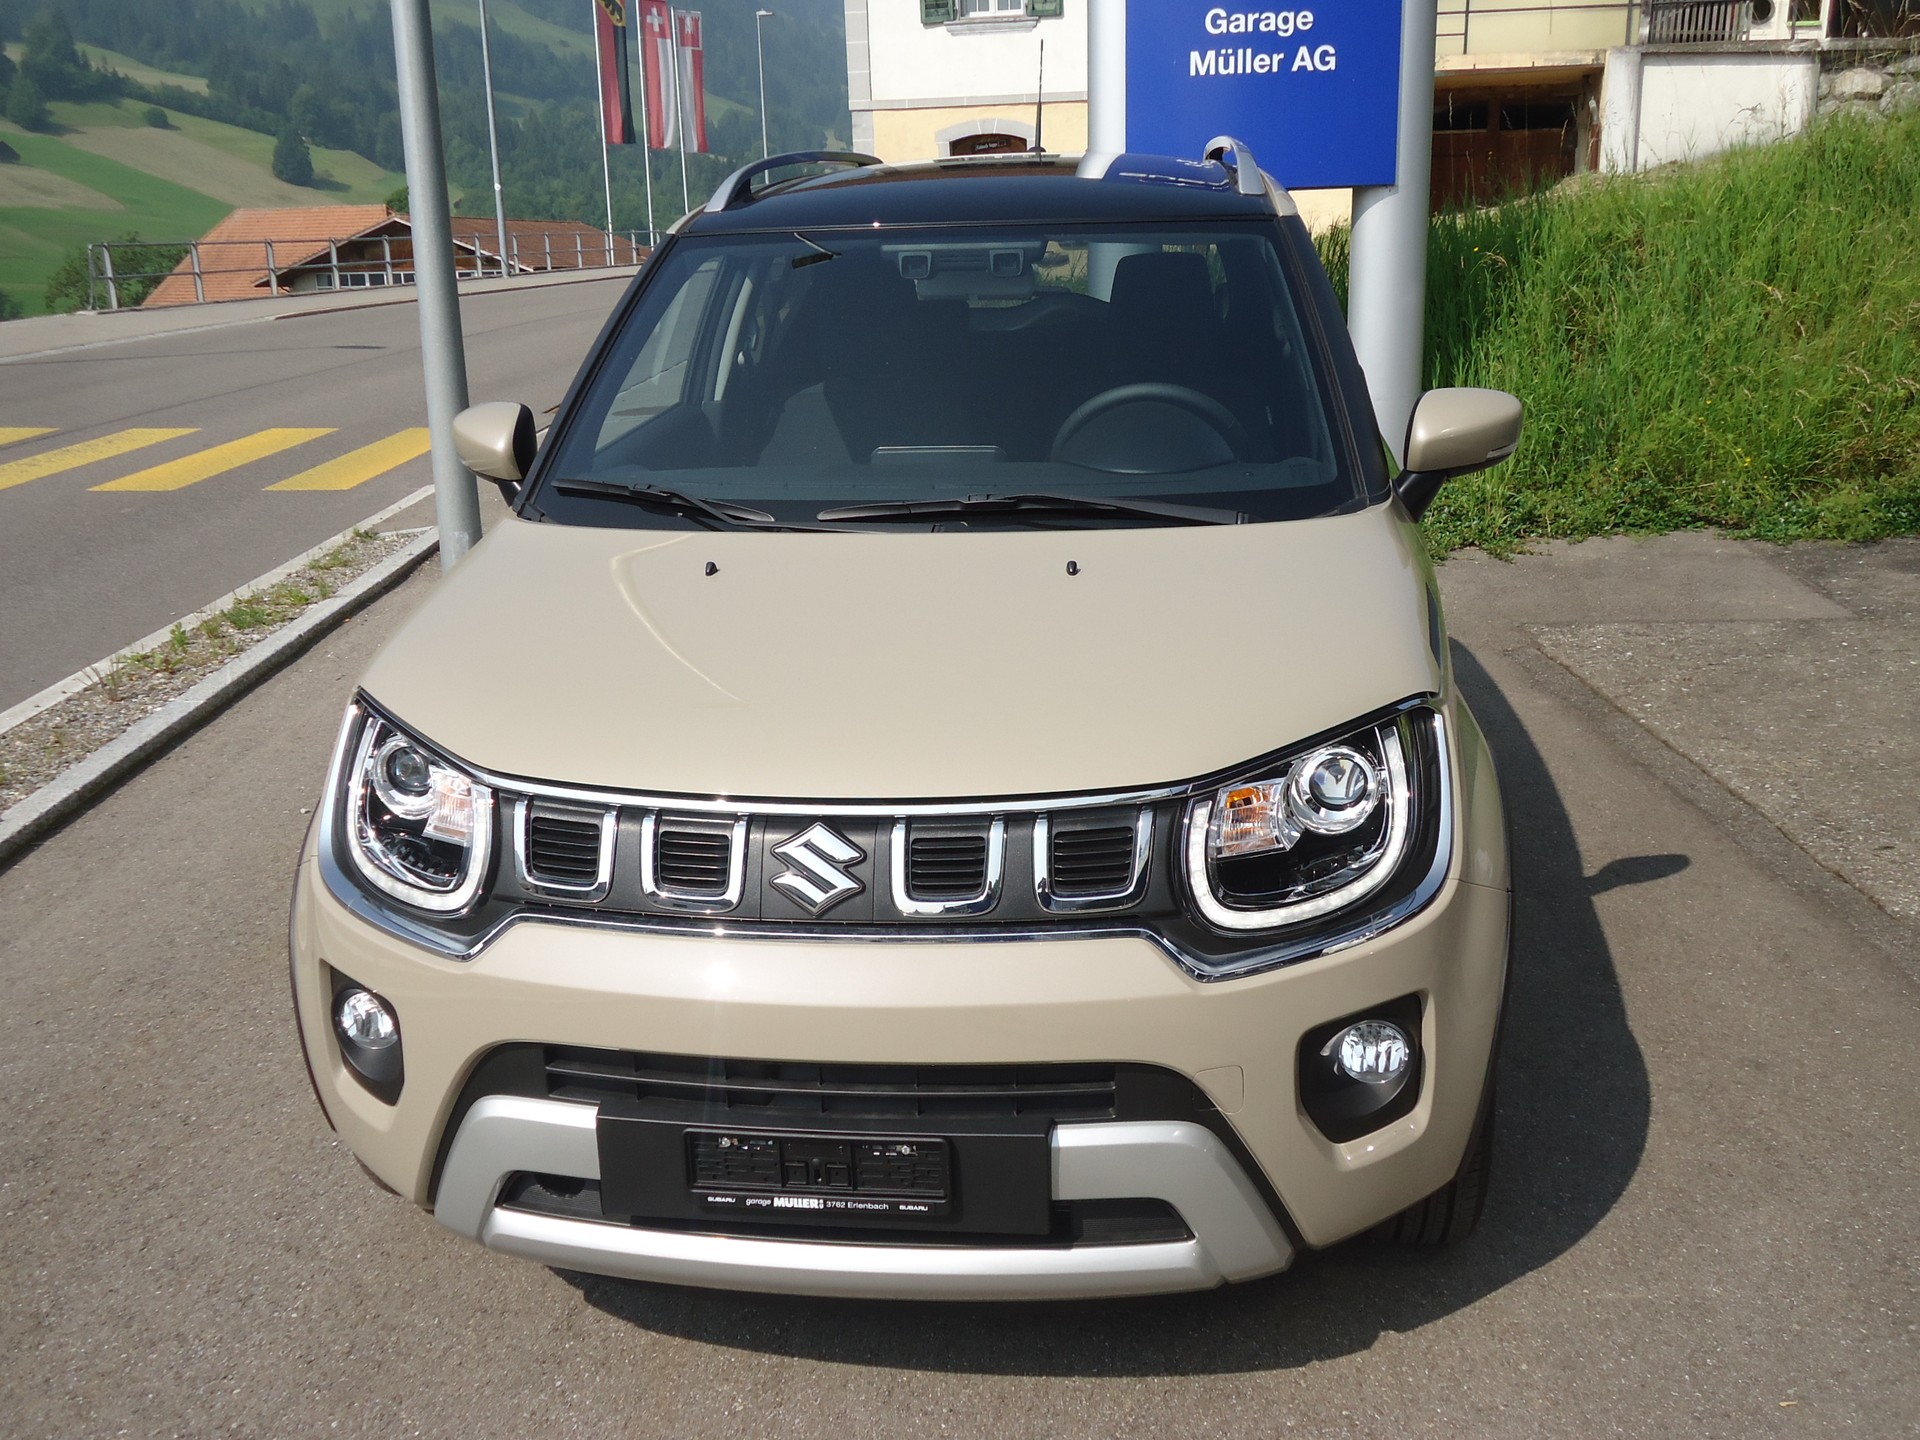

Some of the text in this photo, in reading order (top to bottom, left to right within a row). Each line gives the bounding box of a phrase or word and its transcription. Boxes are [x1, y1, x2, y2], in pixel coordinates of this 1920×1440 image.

[1205, 8, 1314, 37] Garage
[1189, 44, 1336, 76] Müller AG
[745, 1198, 772, 1207] garage
[847, 1201, 889, 1210] Erlenbach
